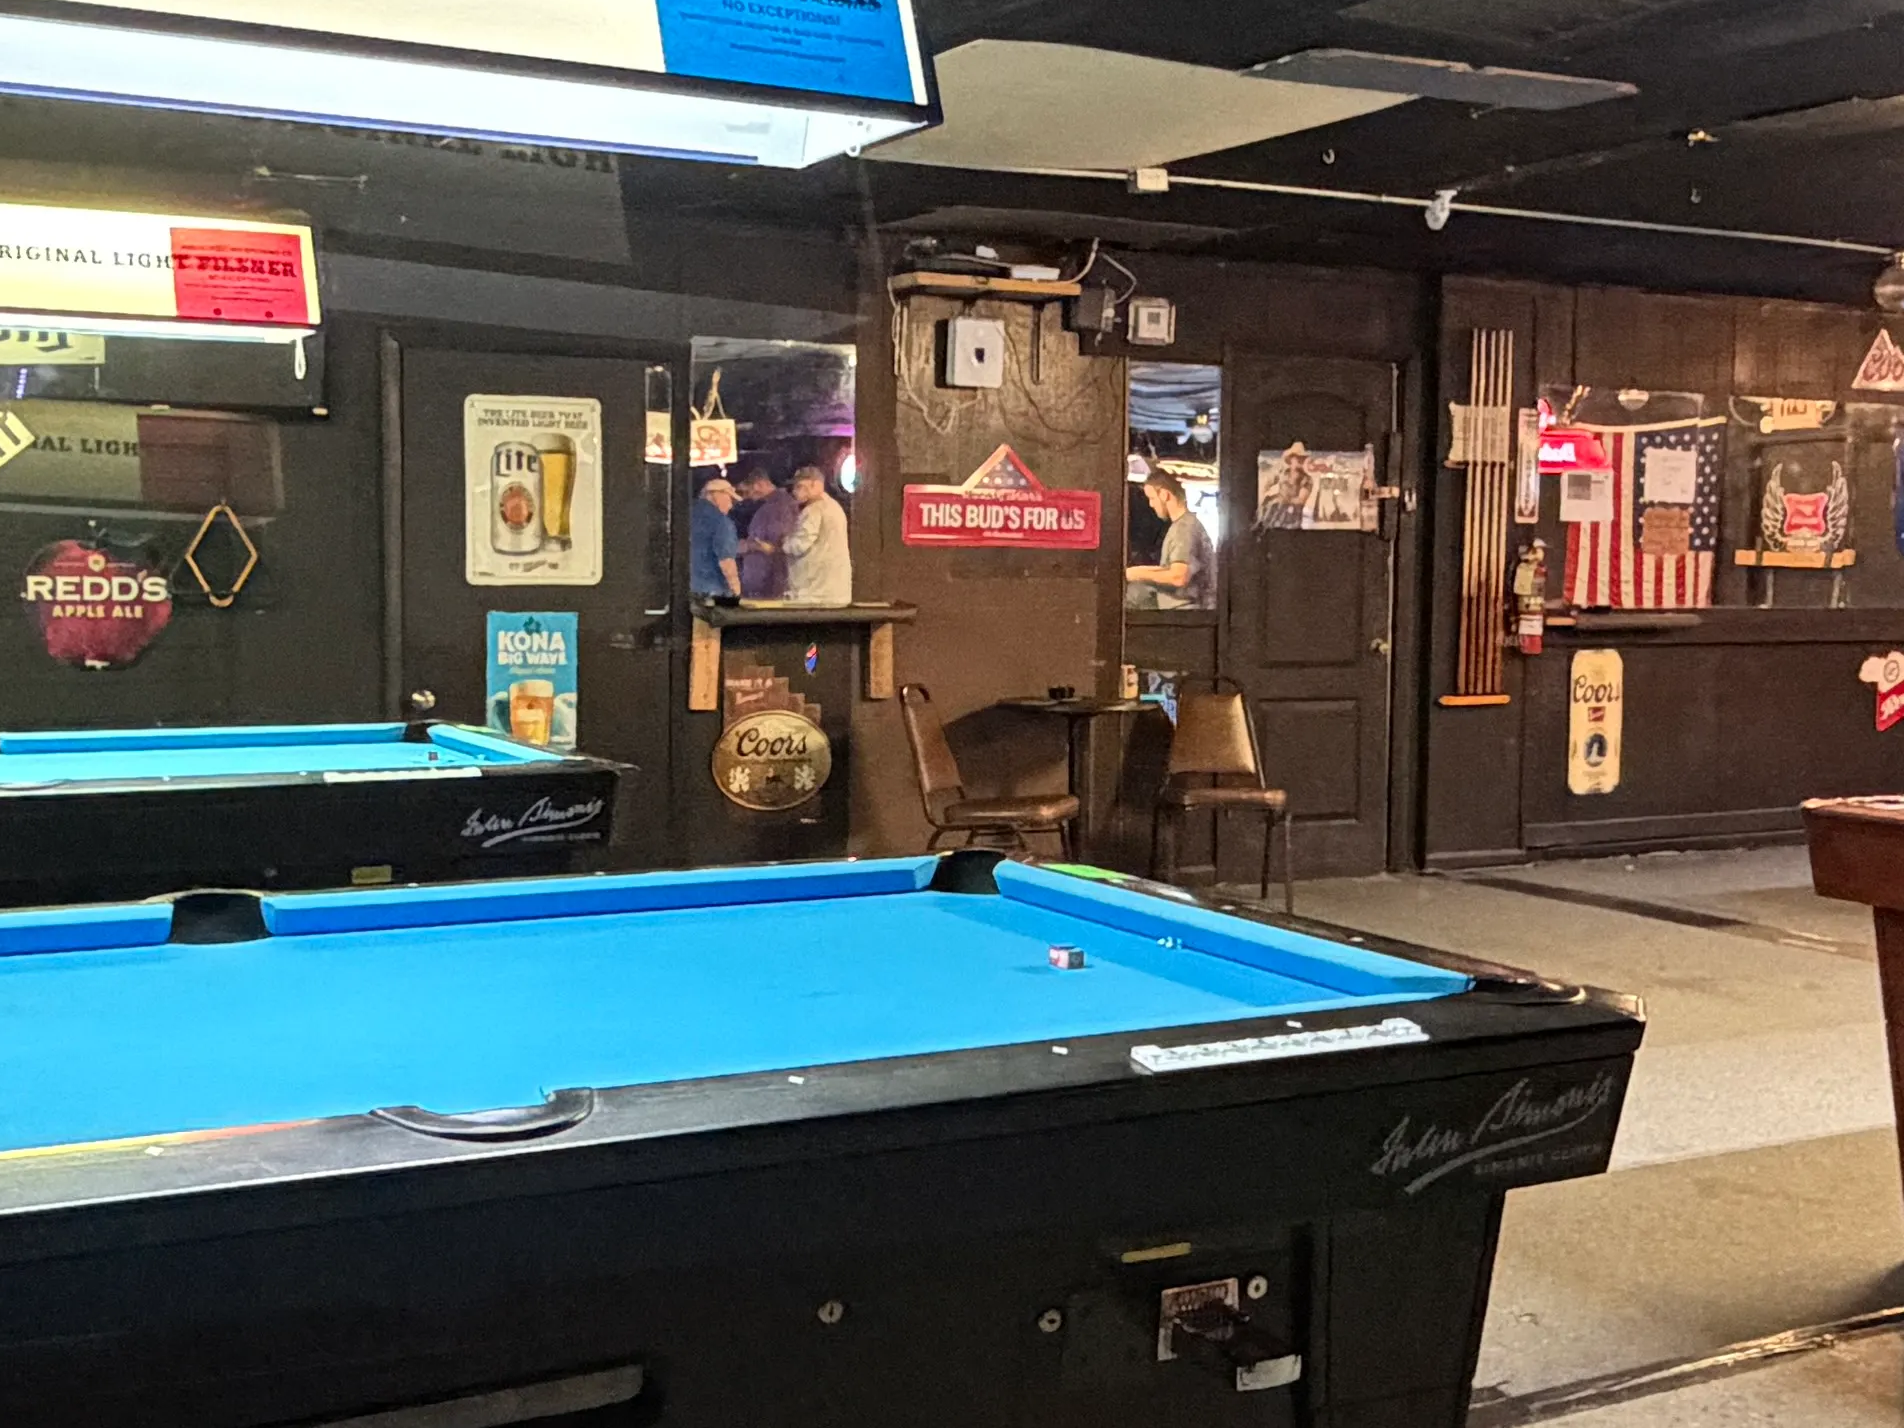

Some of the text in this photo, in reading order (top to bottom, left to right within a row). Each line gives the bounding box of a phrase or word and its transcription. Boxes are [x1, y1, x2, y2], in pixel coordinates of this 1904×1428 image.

[113, 251, 190, 271] LIGHT
[194, 255, 298, 278] PILSNER
[495, 448, 539, 478] Lite
[919, 502, 1086, 531] THIS BUD'S FOR US
[26, 570, 170, 603] REDD'S
[51, 604, 144, 619] APPLE ALE
[497, 629, 566, 652] KONA
[497, 651, 569, 666] BIG WAVE
[736, 727, 808, 758] Coors
